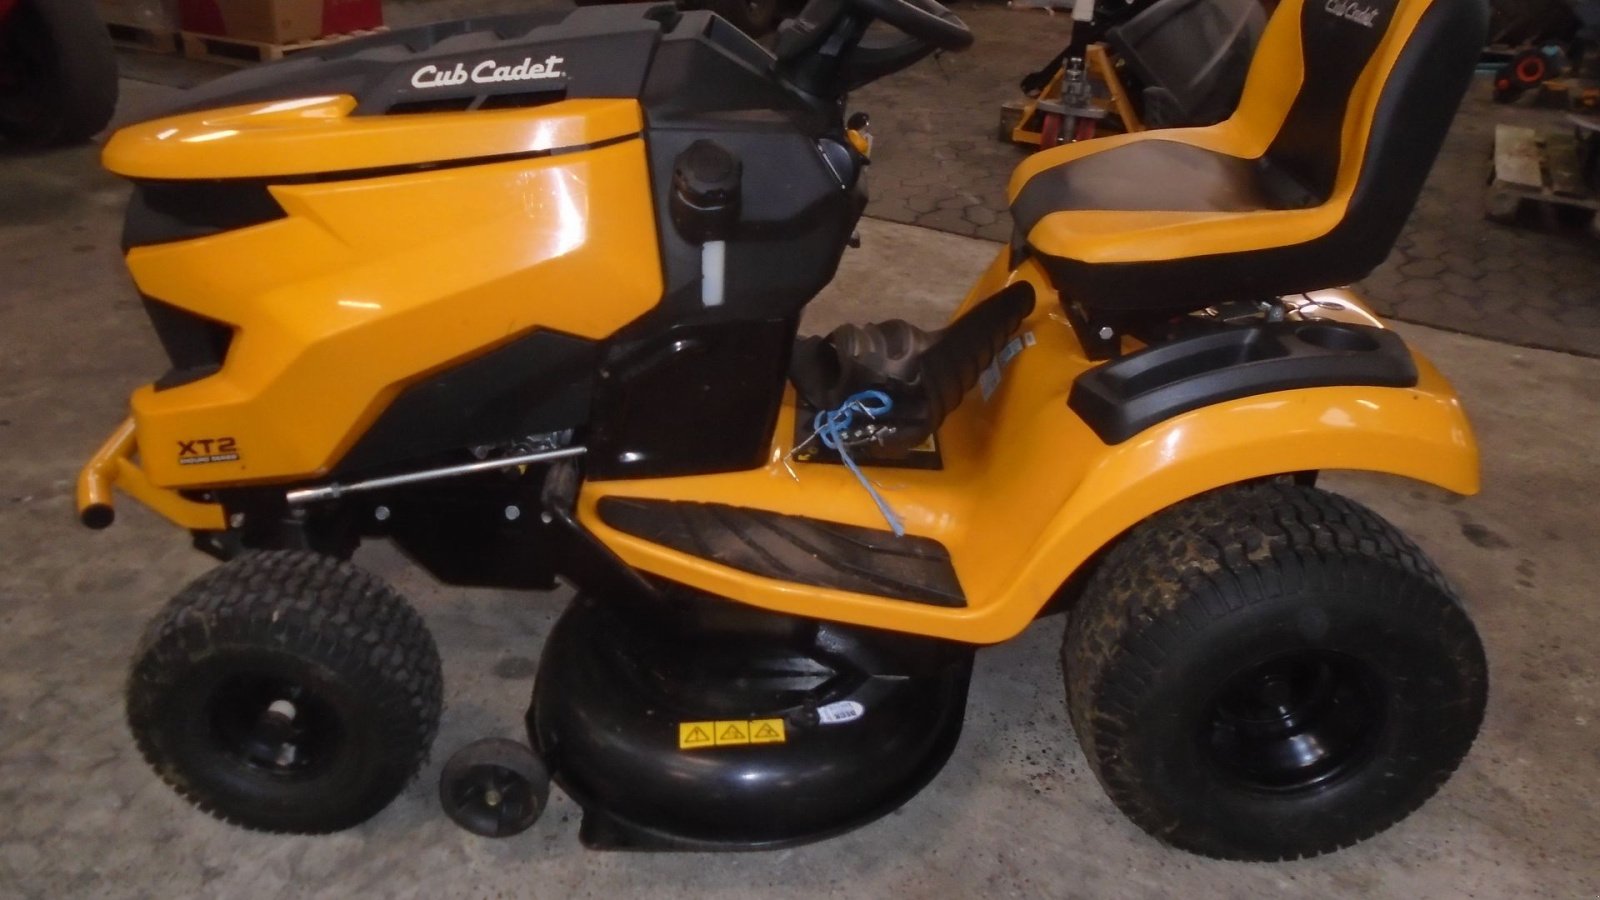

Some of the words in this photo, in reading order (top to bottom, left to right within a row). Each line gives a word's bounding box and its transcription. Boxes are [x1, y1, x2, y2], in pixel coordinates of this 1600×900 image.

[1344, 2, 1379, 28] Cadet
[411, 63, 468, 88] Cub
[471, 55, 564, 83] Cadet
[177, 437, 237, 455] XT2
